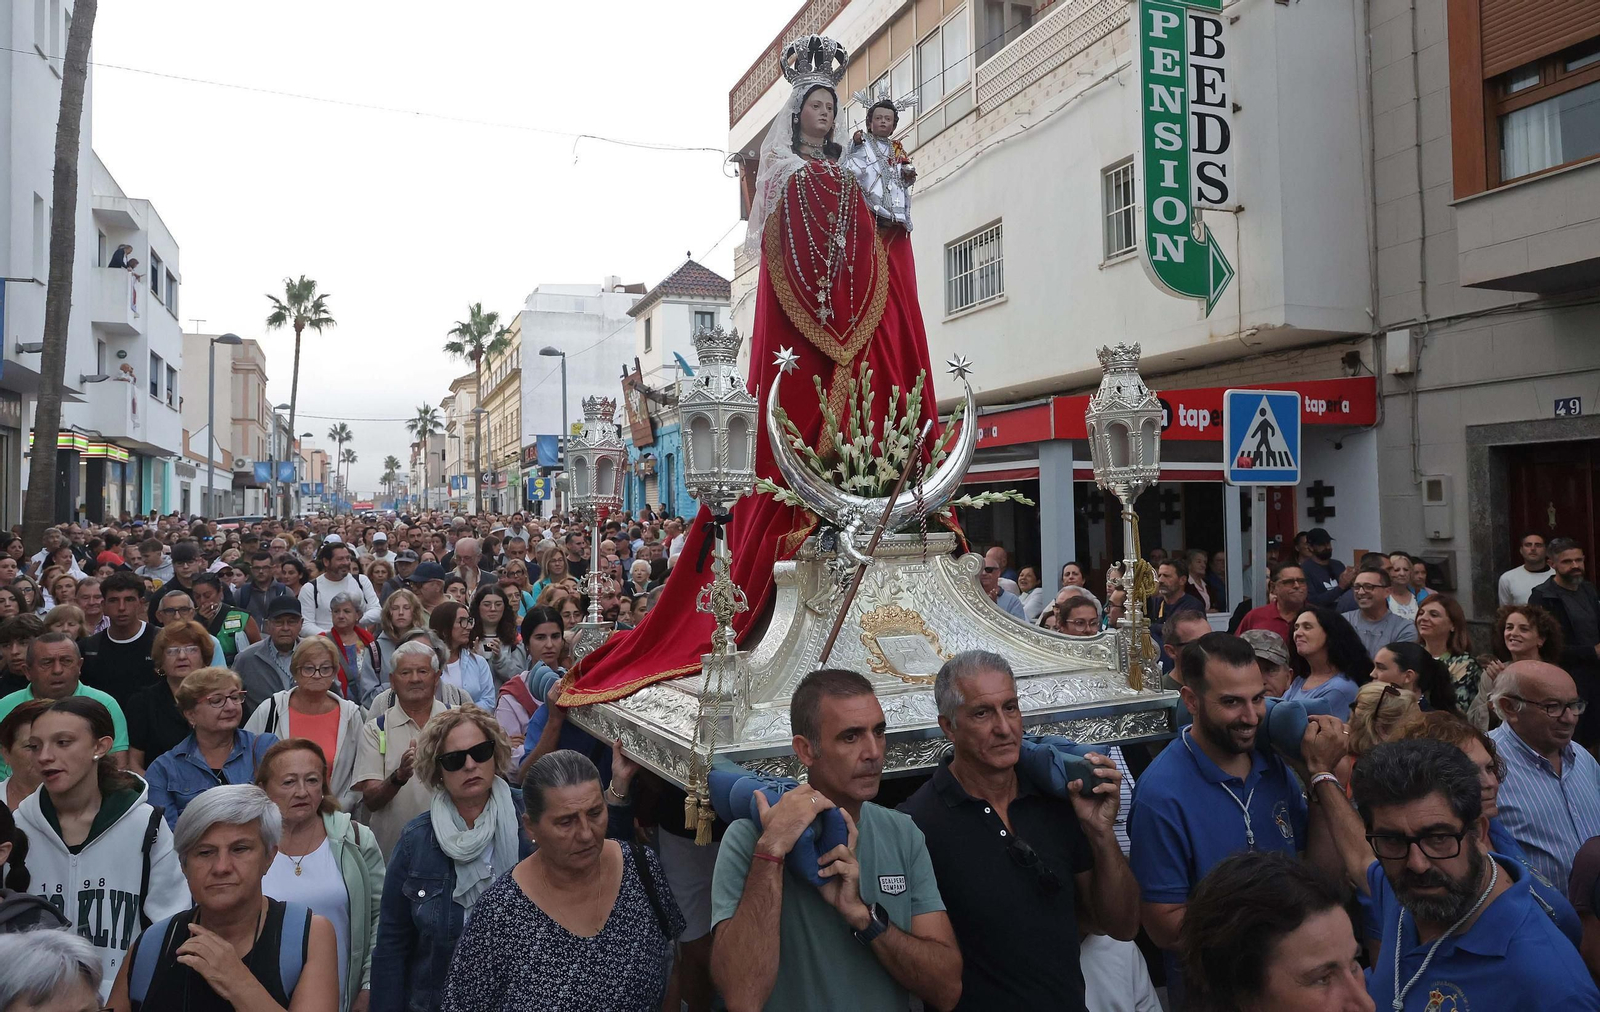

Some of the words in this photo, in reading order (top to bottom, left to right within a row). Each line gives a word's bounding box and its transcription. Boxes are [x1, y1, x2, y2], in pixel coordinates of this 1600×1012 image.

[1189, 15, 1230, 204] BEDS
[1149, 9, 1188, 263] PENSION
[1178, 403, 1224, 432] tape
[1305, 395, 1349, 416] tapería
[1556, 398, 1580, 416] 49
